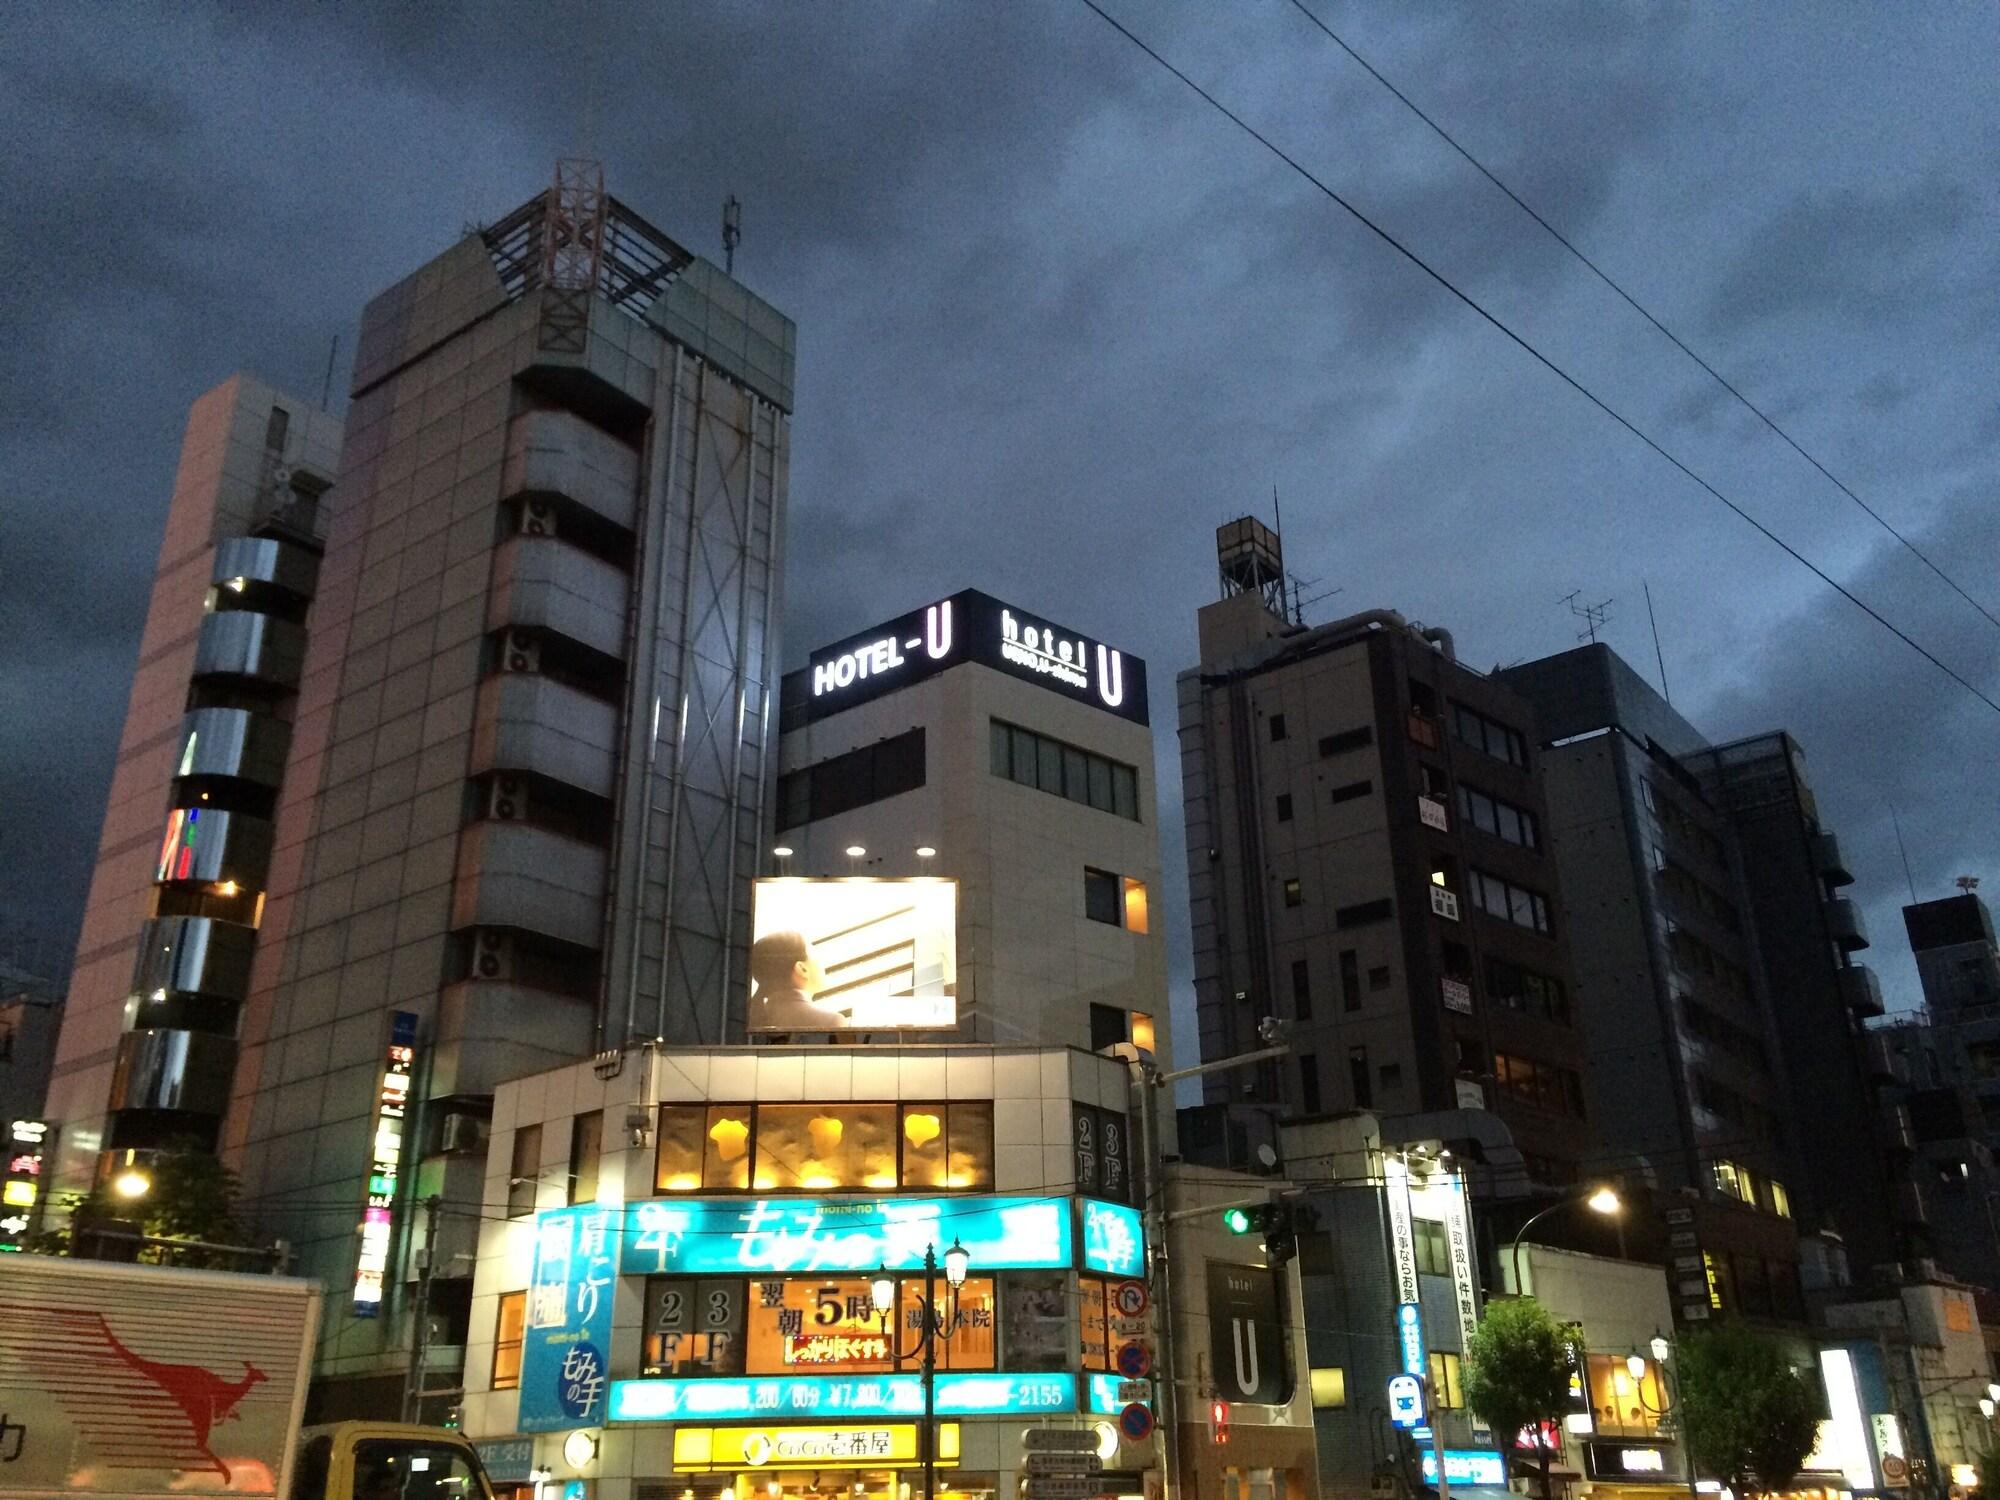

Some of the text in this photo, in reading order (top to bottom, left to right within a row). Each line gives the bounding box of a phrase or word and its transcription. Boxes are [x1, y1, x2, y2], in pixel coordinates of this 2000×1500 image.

[1002, 609, 1123, 707] hotel U
[1227, 1276, 1255, 1291] hotel
[1232, 1317, 1260, 1396] U
